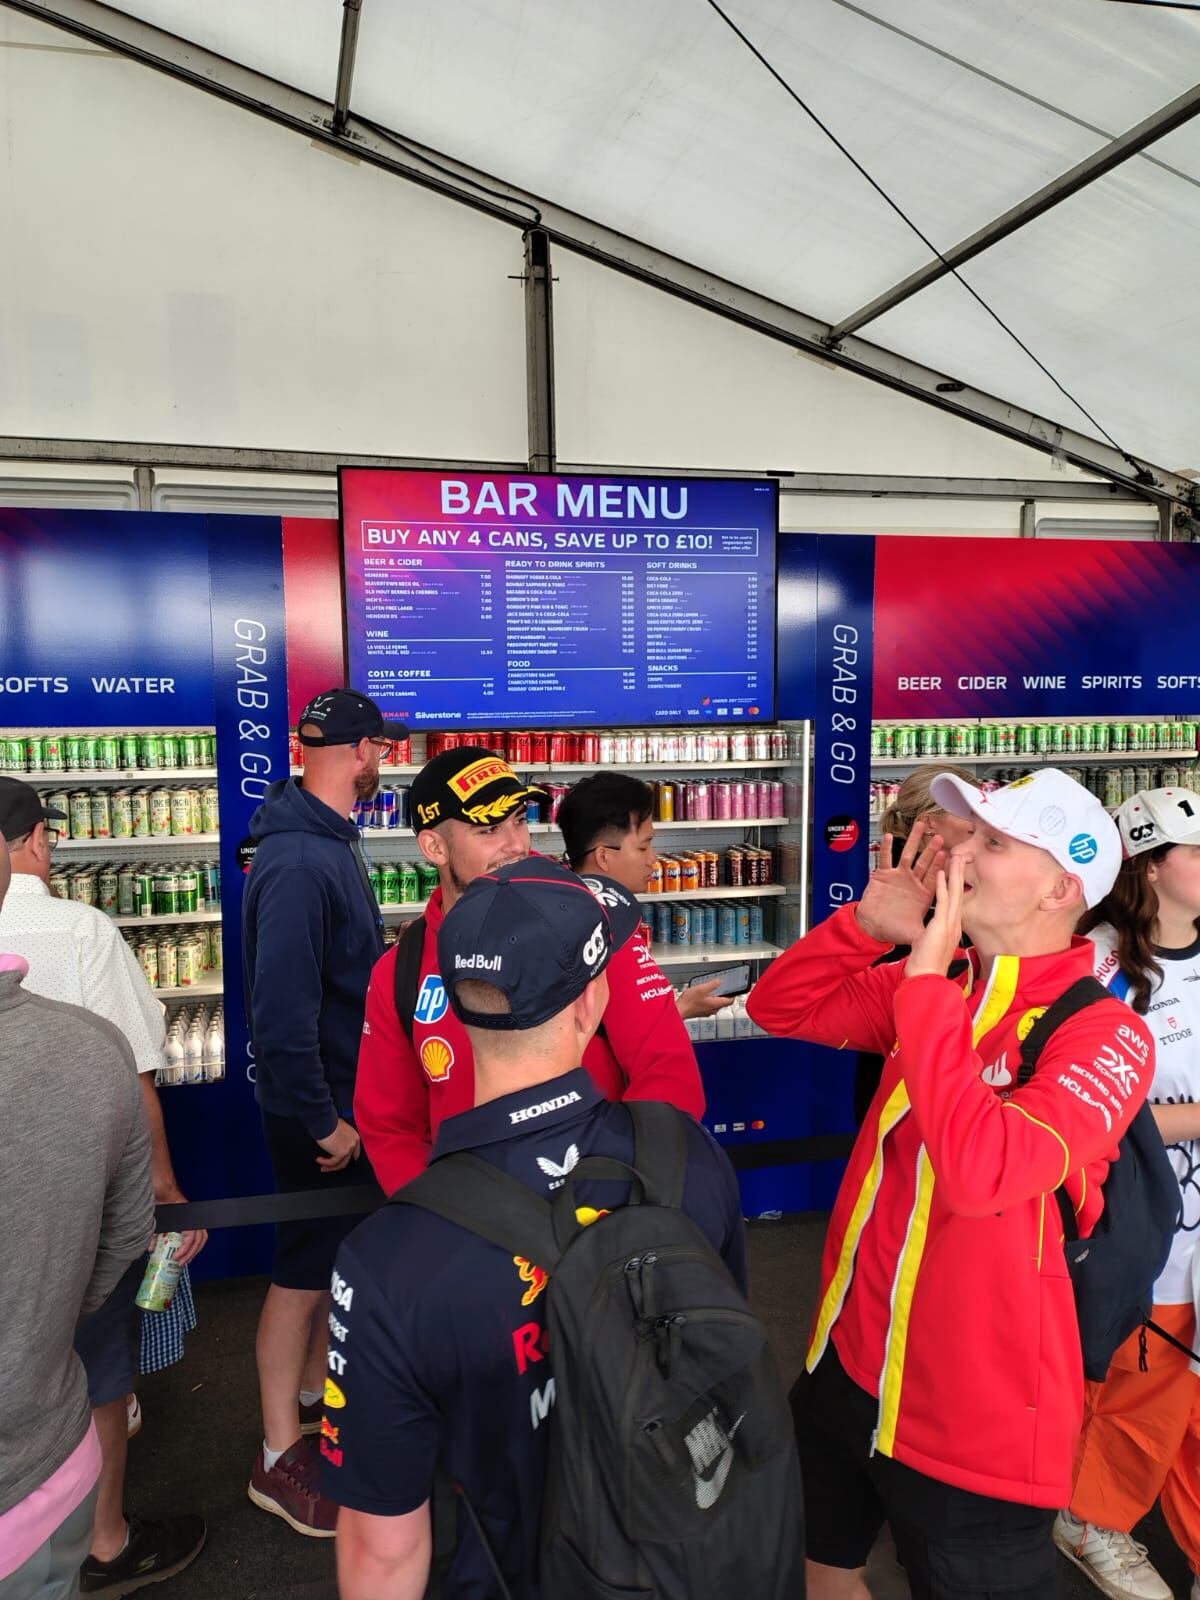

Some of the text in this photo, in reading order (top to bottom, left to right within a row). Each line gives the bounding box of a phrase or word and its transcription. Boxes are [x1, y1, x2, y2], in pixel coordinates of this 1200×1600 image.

[440, 479, 688, 520] BAR MENU
[367, 529, 713, 550] BUY ANY 4 CANS, SAVE UP TO £10!
[364, 558, 422, 567] BEER & CIDER
[505, 560, 532, 568] READY
[534, 560, 546, 568] TO
[366, 630, 389, 638] WINE
[234, 618, 268, 709] GRAB
[368, 670, 431, 678] COSTA COFFEE
[508, 660, 530, 668] FOOD
[648, 664, 678, 672] SNACKS
[0, 677, 176, 694] OFTS WATER
[898, 677, 942, 690] BEER
[958, 676, 1007, 690] CIDER
[1023, 676, 1066, 689] WINE
[1082, 676, 1142, 689] SPIRITS
[830, 624, 858, 784] GRAB & GO
[238, 719, 270, 742] &
[417, 802, 440, 824] 1ST
[1177, 800, 1195, 818] 1
[1072, 836, 1095, 859] hp
[455, 954, 502, 971] Red Bull
[416, 986, 445, 1022] hp
[1118, 1024, 1150, 1058] aws
[1070, 1064, 1110, 1096] RICHARD
[1093, 1060, 1128, 1100] TECHNOLOGY
[508, 1091, 582, 1124] HONDA
